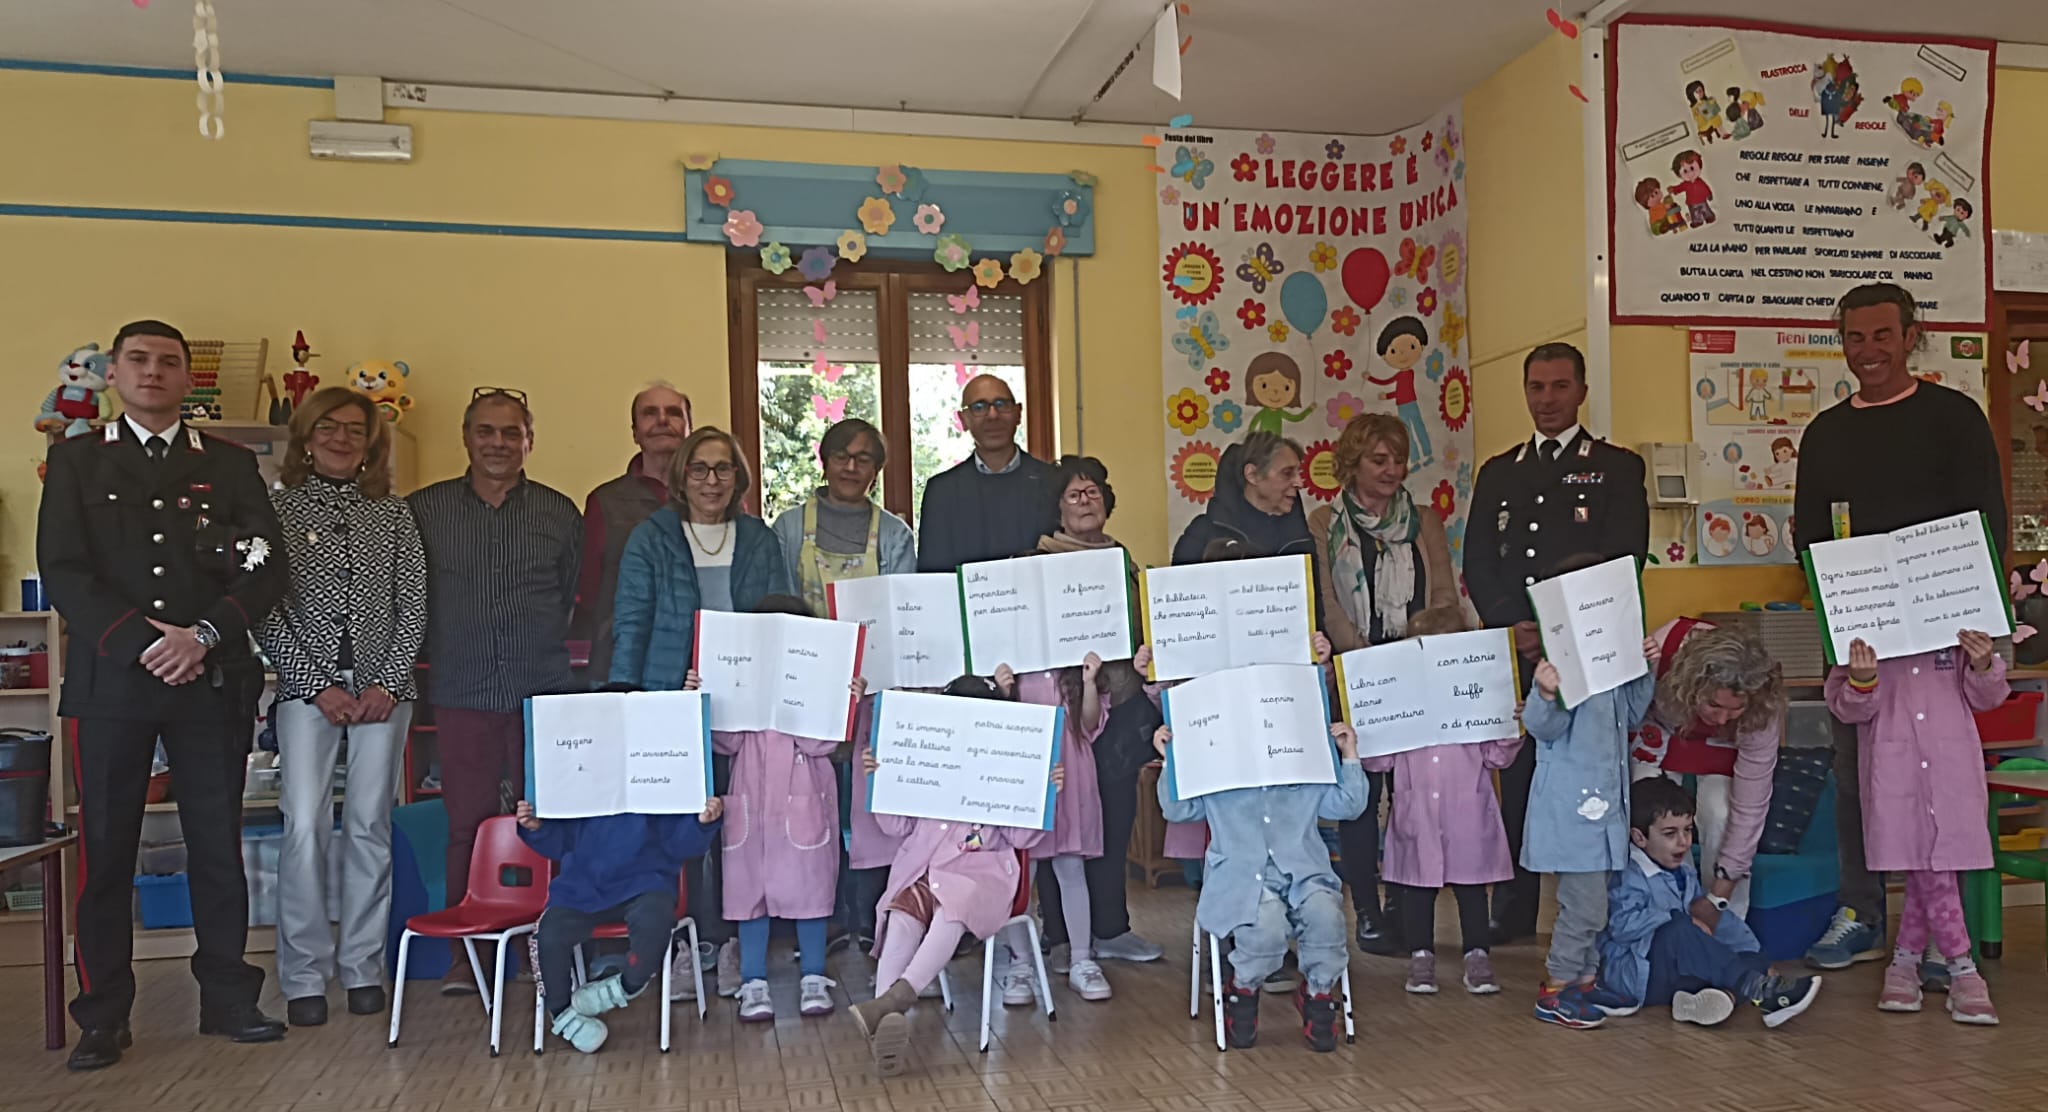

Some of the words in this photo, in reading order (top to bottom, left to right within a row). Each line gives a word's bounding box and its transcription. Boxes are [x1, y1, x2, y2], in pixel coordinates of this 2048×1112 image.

[1760, 63, 1808, 79] FILASTROCCA
[1789, 108, 1810, 118] DELLE
[1855, 122, 1886, 131] REGOLE
[1164, 134, 1183, 142] Festa
[1184, 134, 1194, 143] del
[1195, 134, 1213, 144] libro
[1740, 150, 1770, 161] REGOLE
[1772, 152, 1803, 162] REGOLE
[1808, 155, 1822, 164] PER
[1824, 155, 1850, 165] STARE
[1857, 157, 1890, 167] INSIEME
[1265, 158, 1393, 192] LEGGERE
[1406, 152, 1418, 185] È
[1735, 172, 1751, 182] CHE
[1758, 175, 1803, 187] RISPETTARE
[1803, 178, 1810, 187] A
[1817, 179, 1840, 189] TUTTI
[1182, 197, 1387, 237] UN'EMOZIONE
[1400, 180, 1458, 232] UNICA
[1734, 199, 1753, 209] UNO
[1754, 200, 1771, 211] ALLA
[1772, 201, 1795, 212] VOLTA
[1804, 204, 1814, 213] LE
[1872, 207, 1877, 216] E
[1733, 223, 1754, 232] TUTTI
[1755, 224, 1784, 235] QUANTI
[1786, 226, 1794, 234] LE
[1689, 243, 1708, 253] ALZA
[1710, 244, 1720, 253] LA
[1722, 243, 1748, 254] MANO
[1755, 246, 1770, 255] PER
[1773, 246, 1807, 256] PARLARE
[1851, 250, 1883, 260] SEMPRE
[1890, 250, 1898, 259] DI
[1680, 267, 1706, 276] BUTTA
[1708, 268, 1718, 276] LA
[1719, 269, 1744, 278] CARTA
[1751, 268, 1766, 277] NEL
[1768, 268, 1803, 278] CESTINO
[1805, 270, 1825, 279] NON
[1660, 292, 1700, 303] QUANDO
[1702, 292, 1710, 300] TI
[1718, 293, 1744, 303] CAPITA
[1746, 295, 1755, 304] DI
[1762, 295, 1804, 306] SBAGLIARE
[1805, 297, 1836, 306] CHIEDI
[1776, 332, 1806, 345] Tieni
[1820, 572, 1844, 584] Ogni
[1846, 566, 1882, 577] racconto
[968, 588, 1018, 600] importanti
[1062, 584, 1076, 594] che
[1078, 584, 1106, 596] fanno
[1840, 586, 1870, 596] nuovo
[1872, 582, 1900, 592] mondo
[1578, 596, 1614, 612] davvero
[1912, 595, 1924, 604] che
[973, 608, 988, 617] per
[1830, 604, 1843, 616] che
[1854, 600, 1896, 612] sorprende
[1154, 610, 1167, 620] che
[1834, 624, 1845, 633] da
[1847, 622, 1868, 631] cima
[1876, 616, 1900, 630] fondo
[1059, 633, 1090, 643] mondo
[1091, 630, 1117, 639] intero
[1585, 627, 1604, 637] una
[1156, 638, 1176, 648] ogni
[1178, 632, 1216, 642] bambino
[718, 654, 752, 666] Leggere
[1437, 658, 1459, 668] con
[1462, 652, 1496, 665] storie
[1350, 678, 1374, 690] Libri
[1377, 676, 1397, 686] con
[1453, 683, 1484, 700] buffe
[1260, 696, 1294, 704] scoprire
[1353, 698, 1382, 709] storie
[896, 720, 905, 730] Se
[1188, 713, 1220, 728] Leggere
[1264, 719, 1274, 728] la
[1356, 717, 1366, 728] di
[1368, 709, 1425, 726] avventura
[1441, 722, 1448, 730] o
[1452, 718, 1462, 729] di
[556, 738, 592, 750] Leggere
[892, 738, 917, 748] nella
[920, 739, 951, 752] lettura
[966, 747, 988, 758] ogni
[1268, 745, 1304, 758] fantasia
[630, 776, 670, 784] divertente
